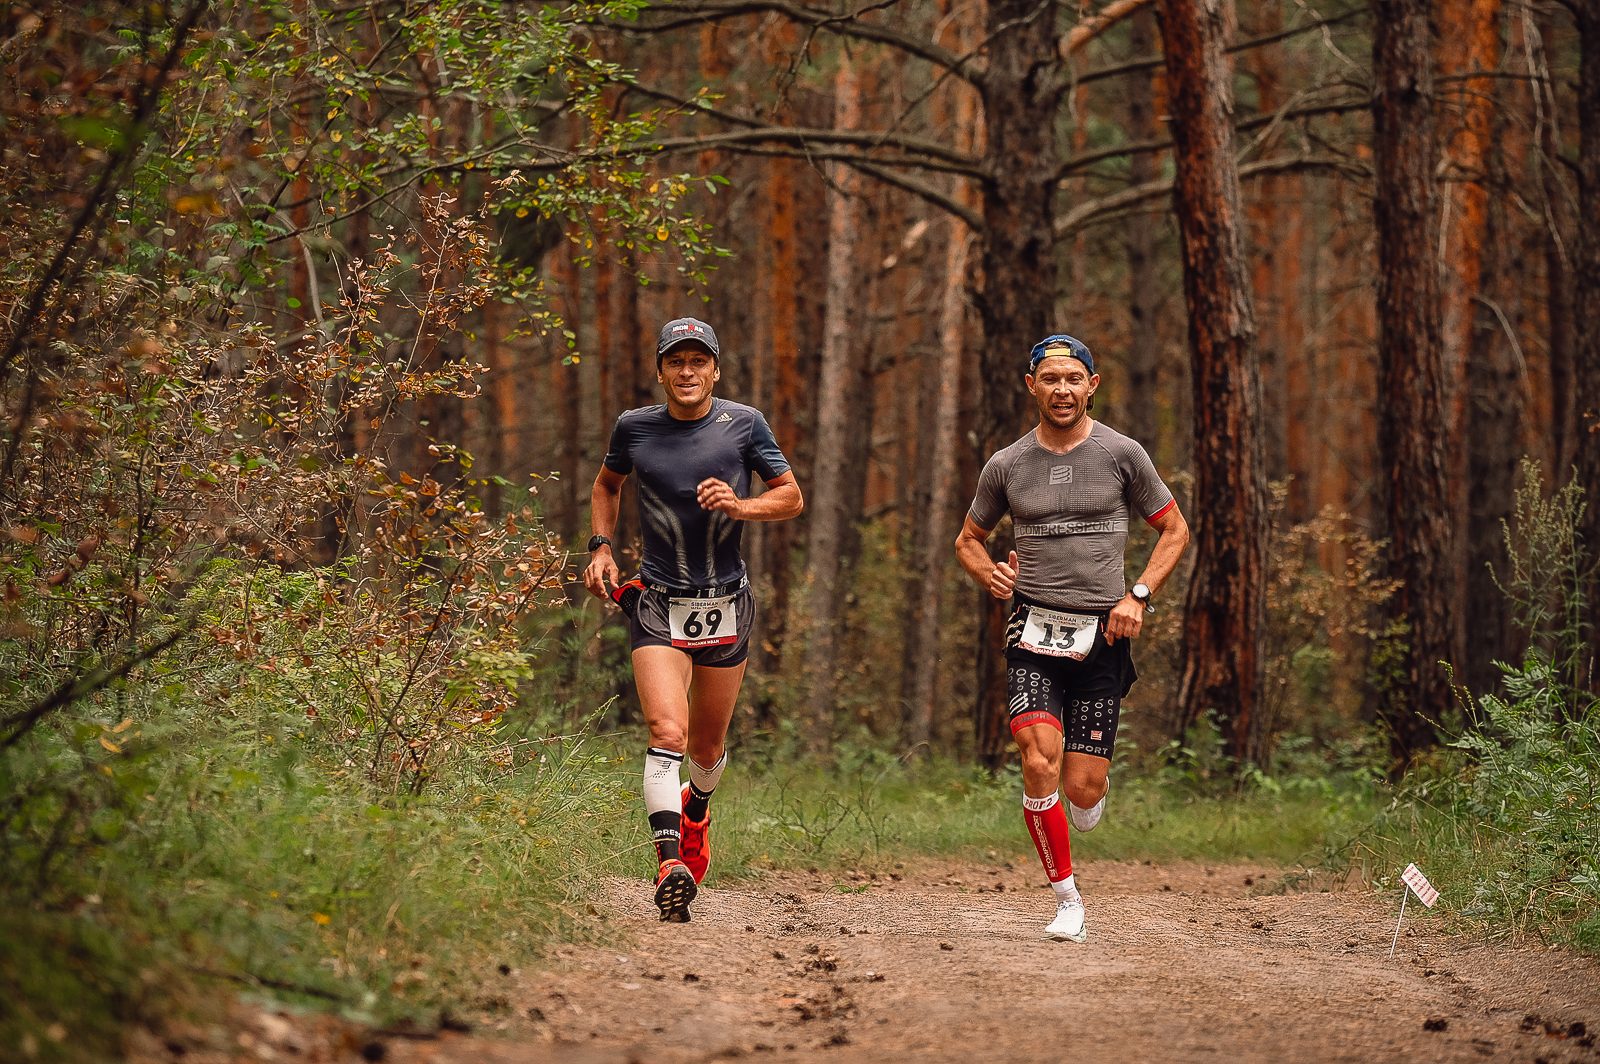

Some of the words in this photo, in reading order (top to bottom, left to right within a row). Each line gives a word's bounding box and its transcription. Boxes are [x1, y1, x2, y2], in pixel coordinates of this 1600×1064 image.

[1020, 521, 1115, 535] COMPRESSPORT
[684, 609, 722, 637] 69
[1038, 622, 1078, 649] 13
